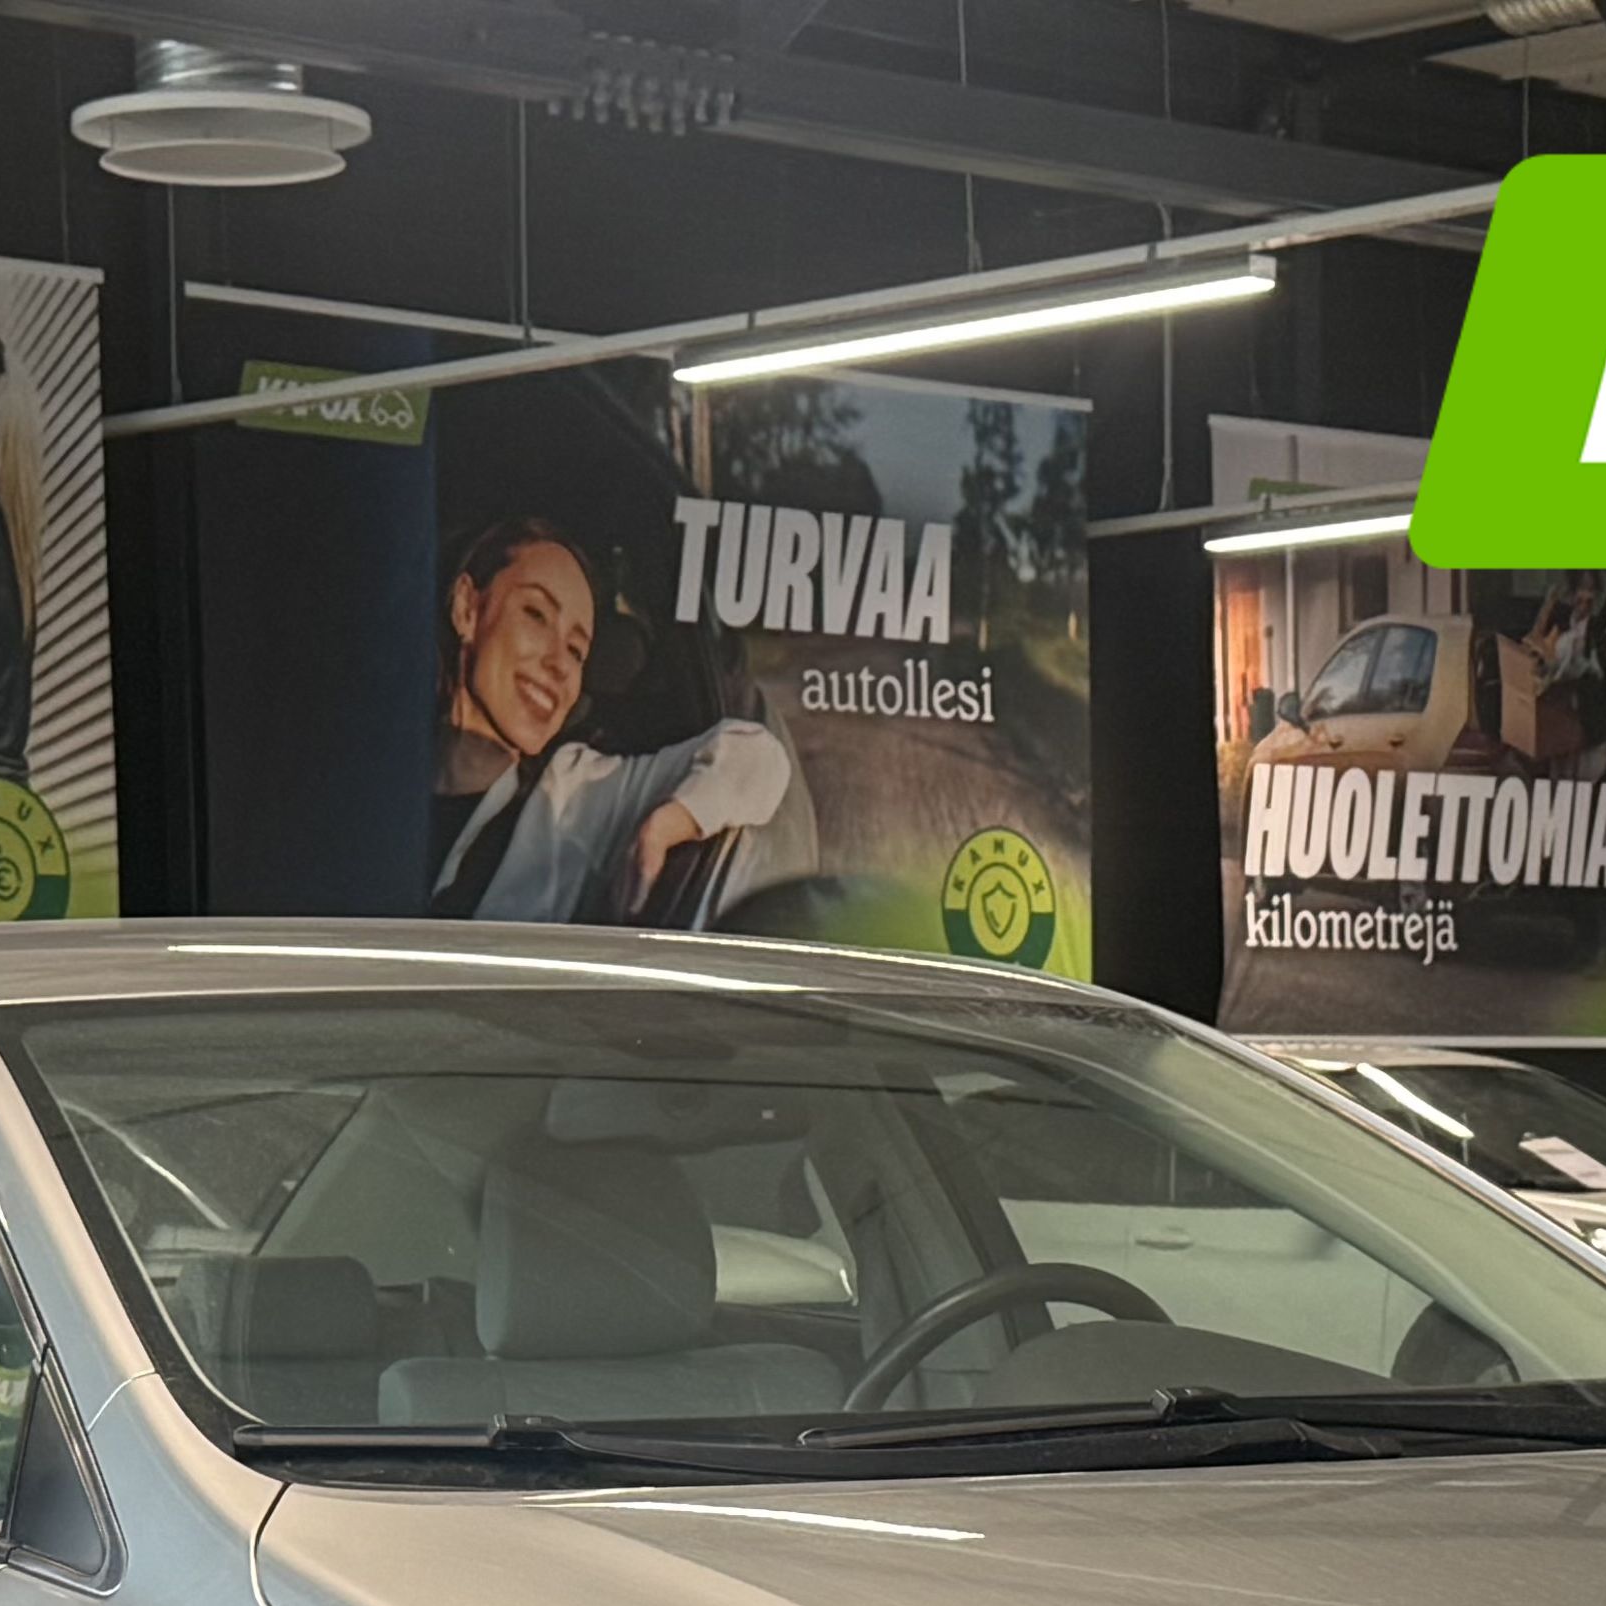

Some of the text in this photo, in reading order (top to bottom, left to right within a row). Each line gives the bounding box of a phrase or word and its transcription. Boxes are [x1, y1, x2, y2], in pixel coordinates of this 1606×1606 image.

[672, 496, 953, 645] TURVAA
[801, 659, 996, 724] autollesi
[952, 837, 1046, 896] KAMUX
[1244, 892, 1459, 966] kilometrejä
